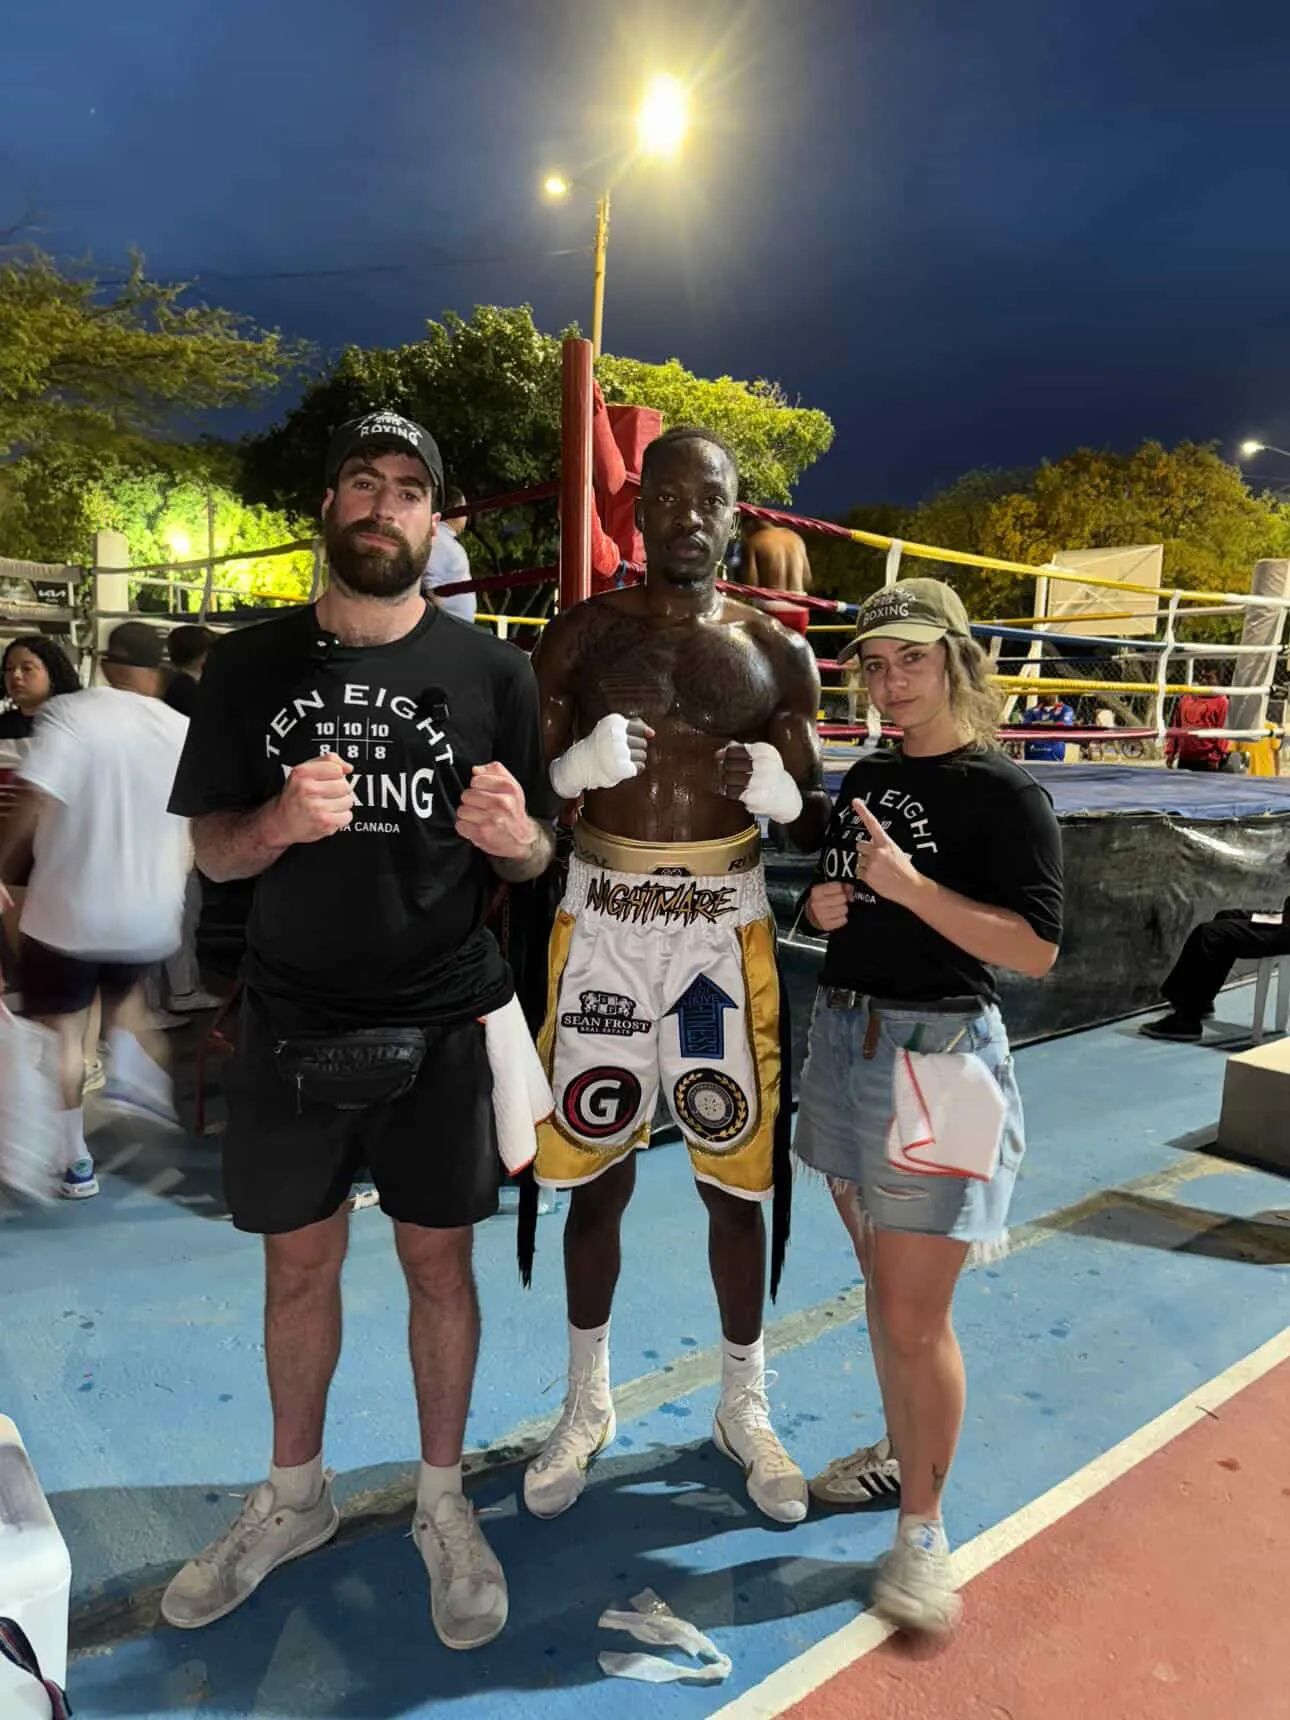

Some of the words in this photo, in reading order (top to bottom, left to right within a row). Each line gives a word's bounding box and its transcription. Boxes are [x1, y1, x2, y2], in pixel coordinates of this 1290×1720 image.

[863, 602, 909, 627] BOXING
[265, 689, 325, 759] TEN
[343, 683, 454, 765] EIGHT
[315, 722, 335, 736] 10
[343, 722, 362, 736] 10
[370, 724, 389, 737] 10
[347, 745, 359, 759] 8
[374, 746, 386, 760] 8
[354, 821, 400, 833] CANADA
[585, 871, 739, 928] NIGHTMARE
[563, 1015, 601, 1027] SEAN
[604, 1018, 649, 1031] FROST
[580, 1079, 621, 1126] G
